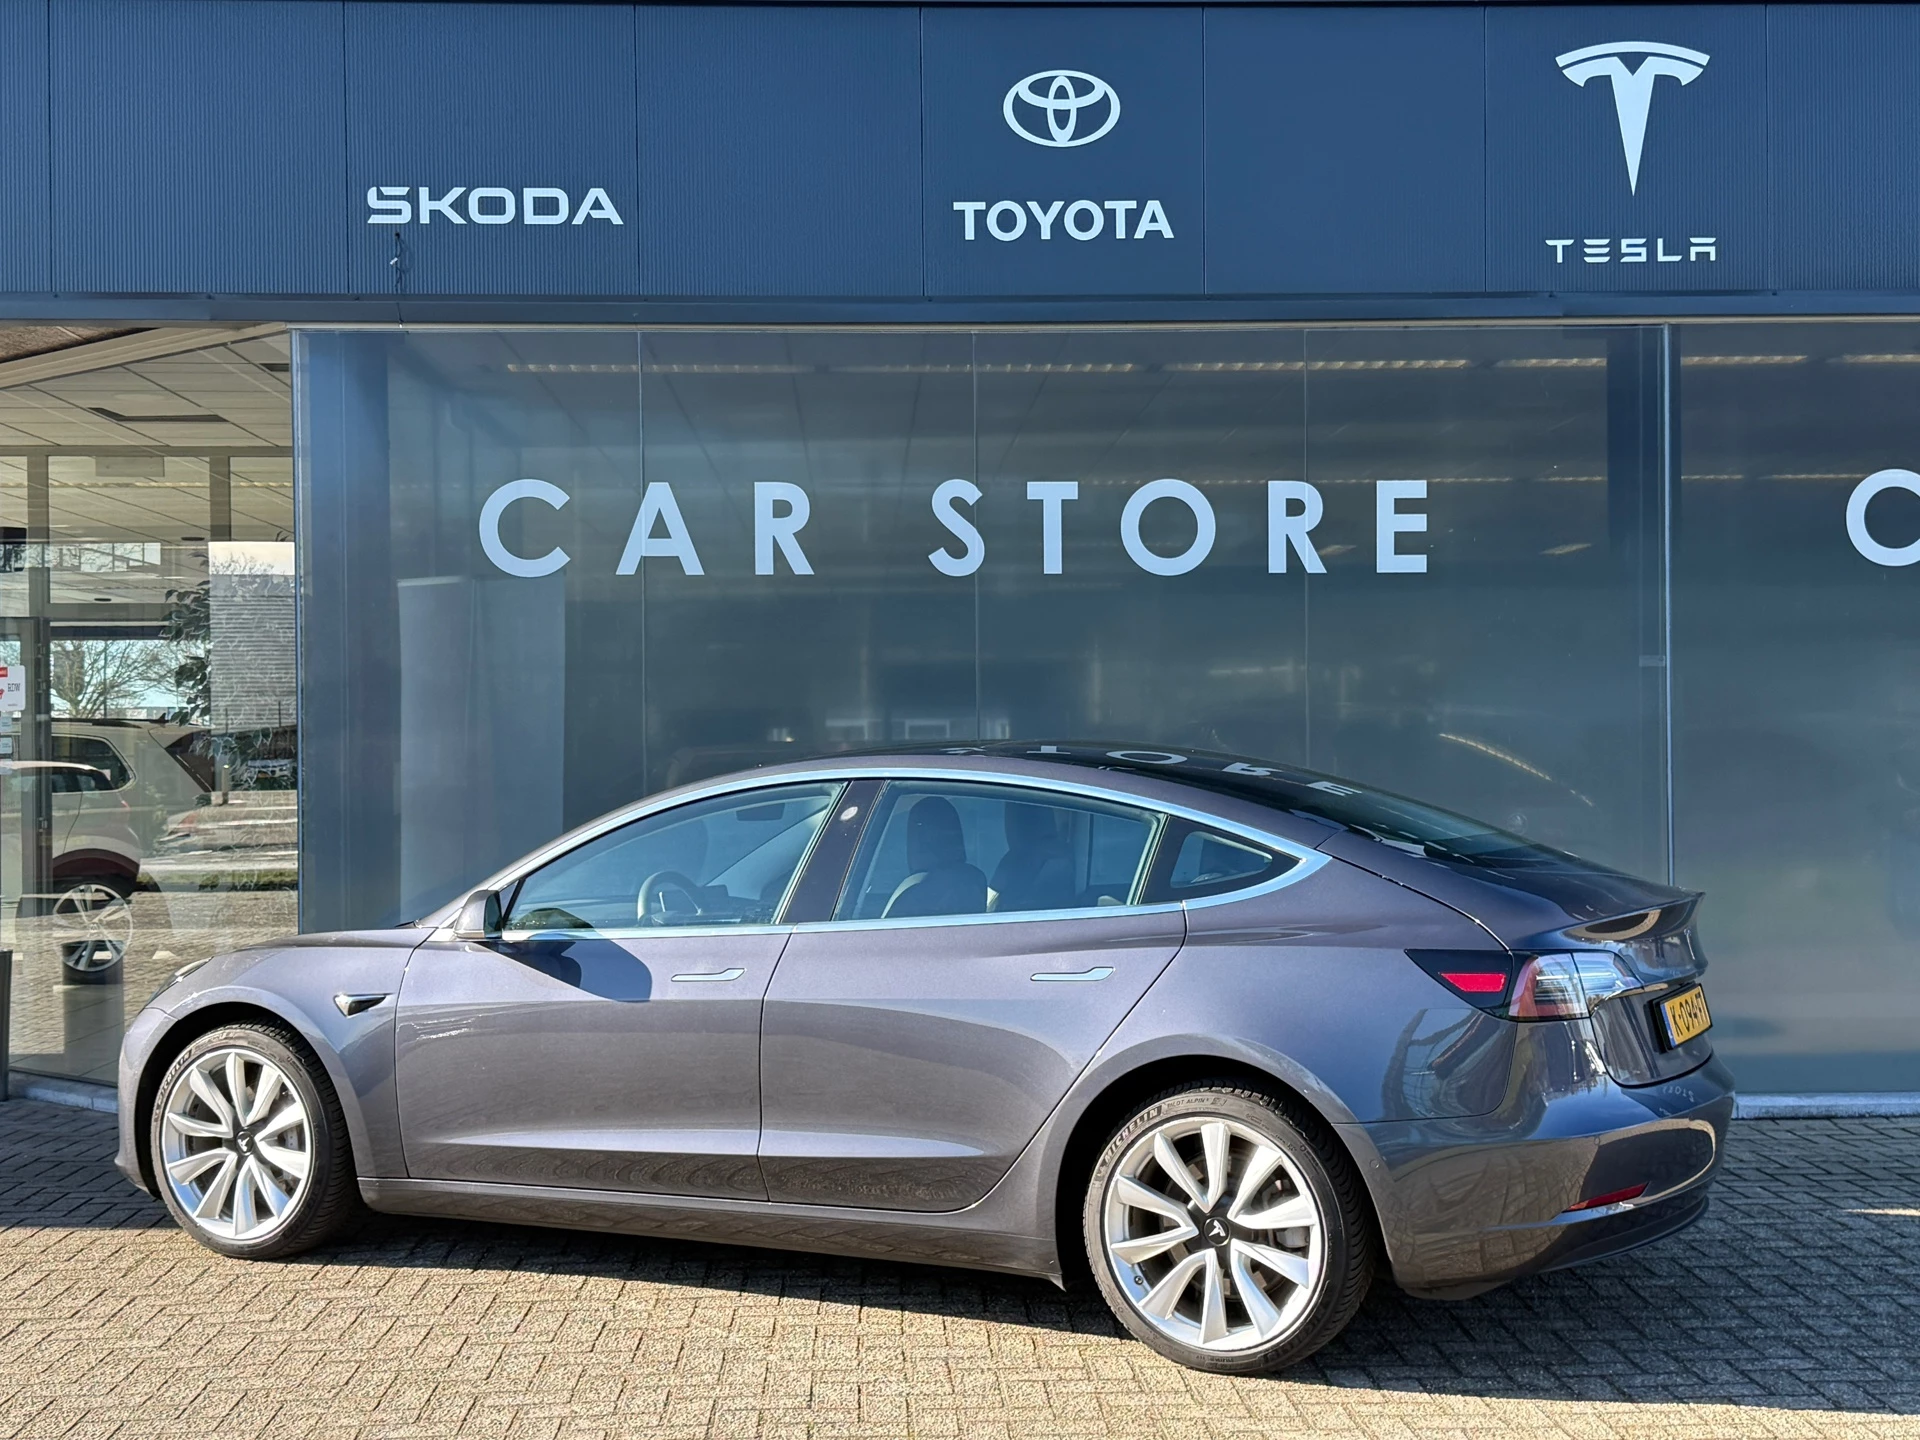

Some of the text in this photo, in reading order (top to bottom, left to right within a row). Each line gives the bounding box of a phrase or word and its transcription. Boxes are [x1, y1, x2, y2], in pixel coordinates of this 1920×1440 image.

[953, 200, 1175, 242] TOYOTA
[1546, 238, 1717, 264] TESLA
[480, 478, 1428, 577] CAR STORE
[1104, 1106, 1159, 1165] MICHELIN
